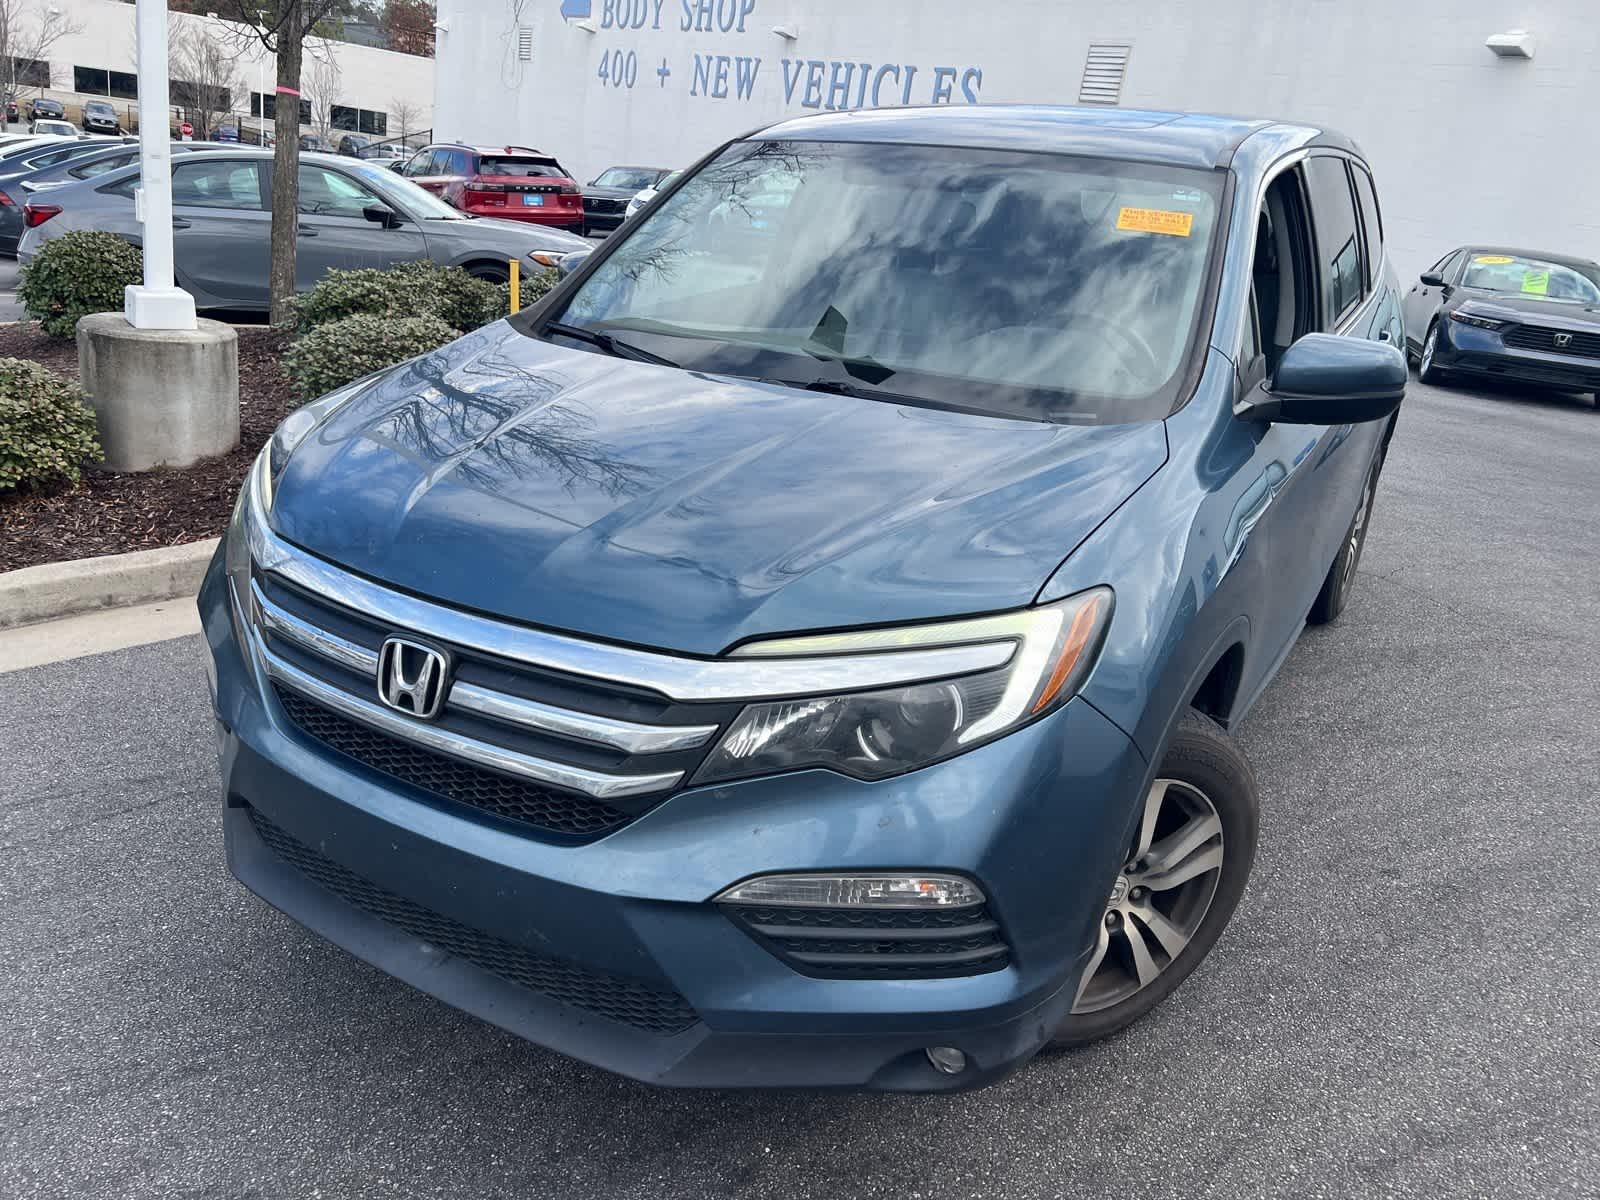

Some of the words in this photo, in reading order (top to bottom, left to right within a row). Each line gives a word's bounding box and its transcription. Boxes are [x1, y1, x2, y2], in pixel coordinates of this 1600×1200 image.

[600, 0, 664, 30] BODY
[680, 0, 756, 33] SHOP
[598, 49, 638, 89] 400
[690, 53, 762, 101] NEW
[781, 58, 983, 110] VEHICLES
